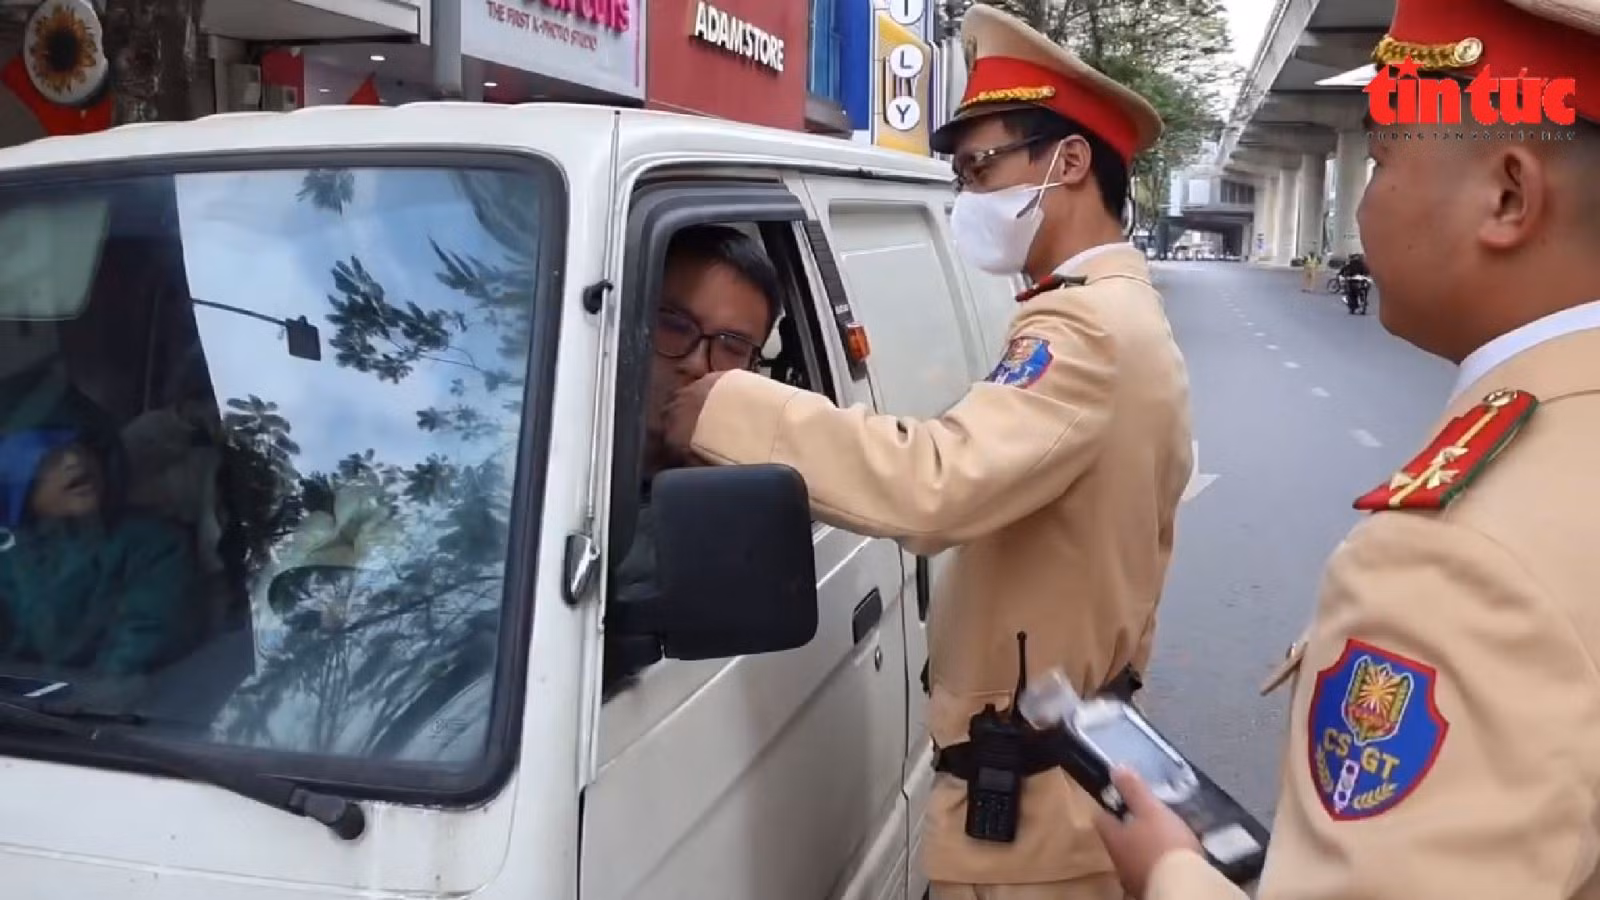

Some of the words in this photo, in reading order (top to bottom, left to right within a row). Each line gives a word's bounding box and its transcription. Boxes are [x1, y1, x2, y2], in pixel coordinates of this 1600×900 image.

[486, 1, 505, 21] THE
[506, 7, 530, 30] FIRST
[1323, 728, 1351, 757] CS
[1360, 747, 1400, 780] GT
